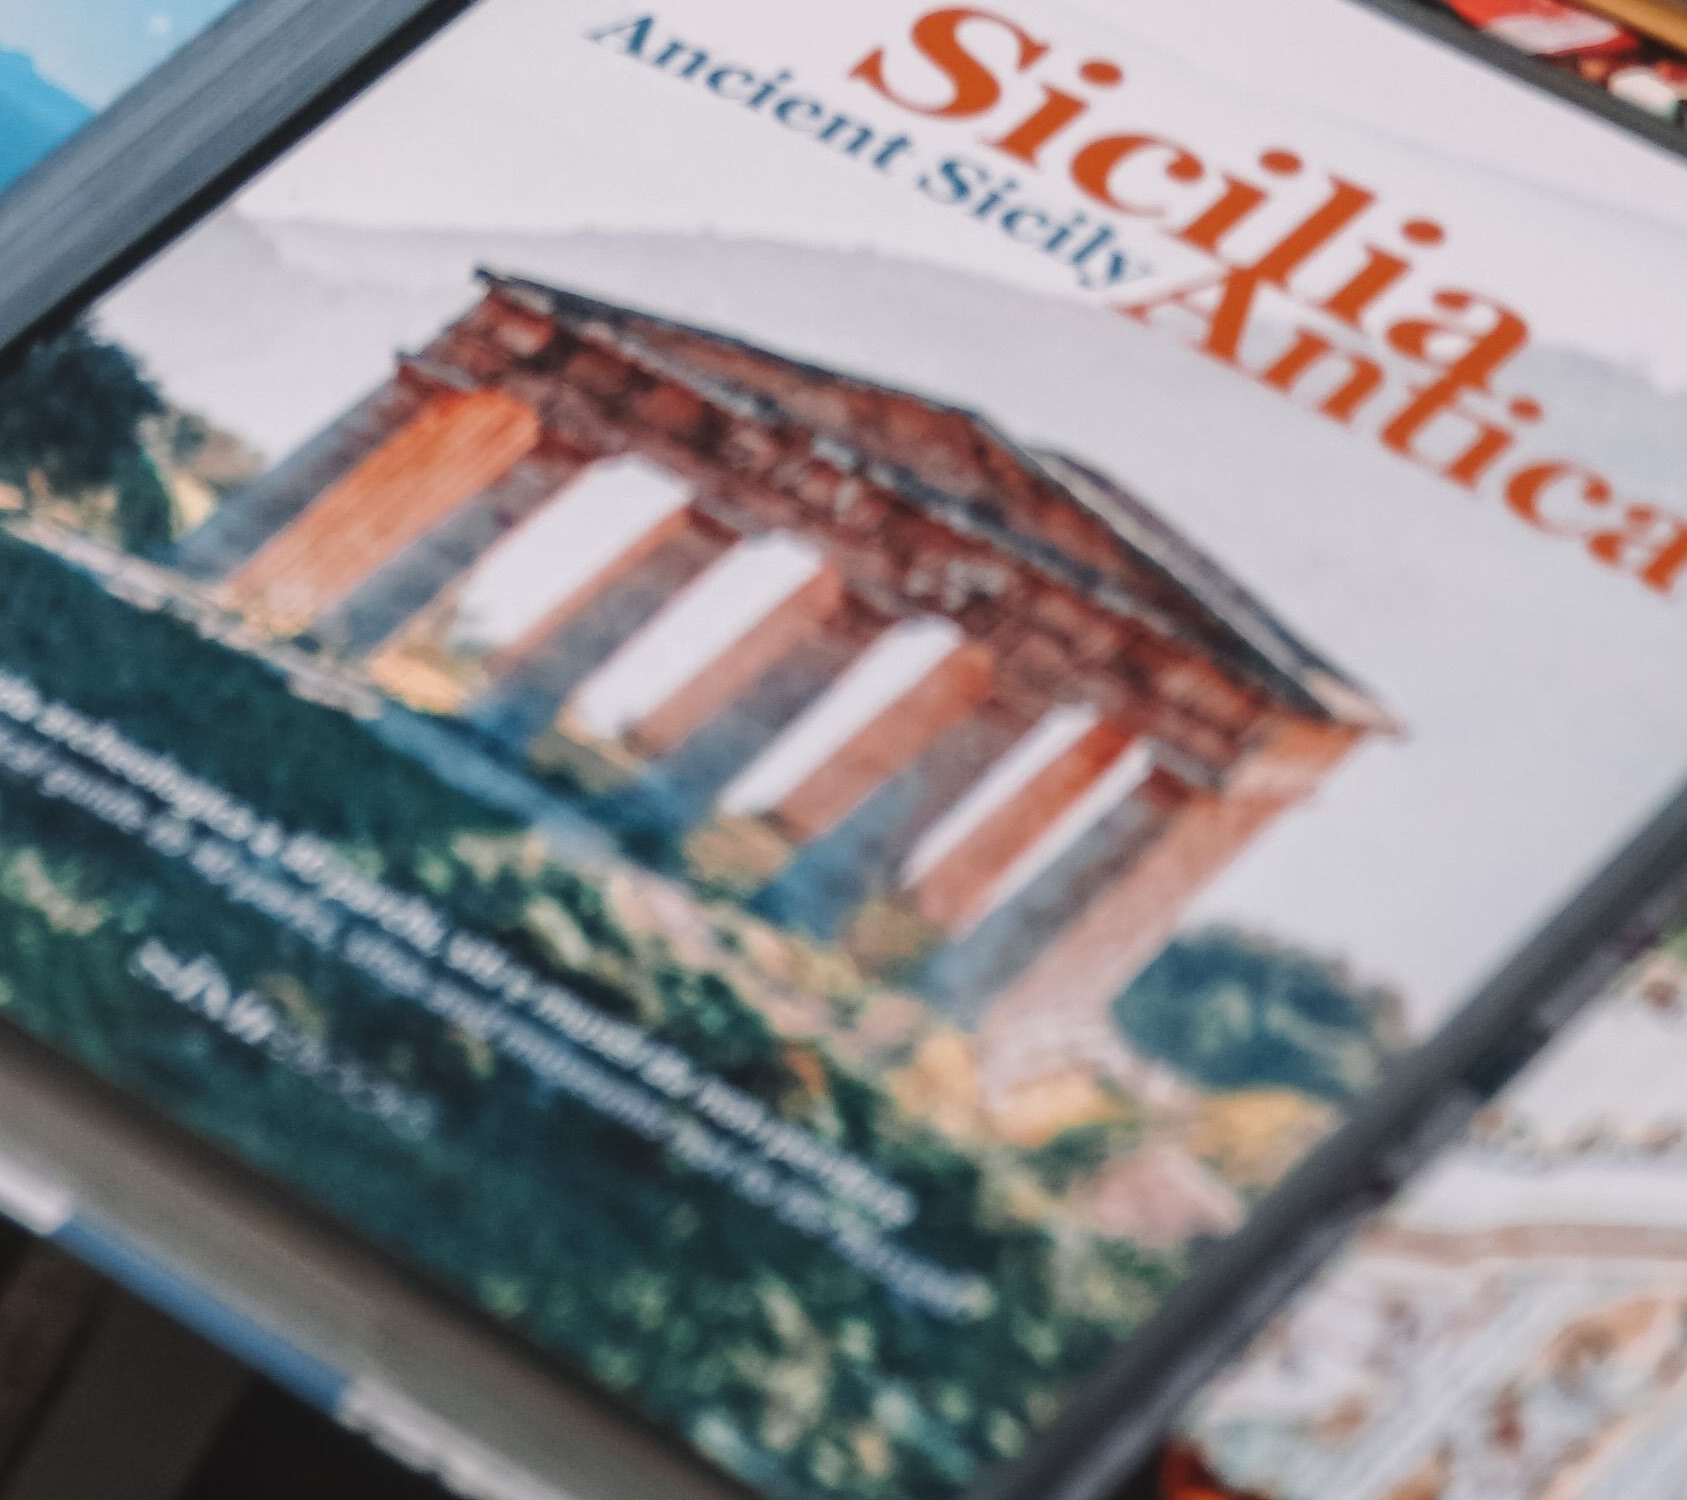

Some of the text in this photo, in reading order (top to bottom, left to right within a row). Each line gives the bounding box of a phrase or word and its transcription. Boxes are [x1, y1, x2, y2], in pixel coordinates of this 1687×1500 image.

[583, 12, 1154, 289] Ancient Sicily
[847, 2, 1531, 400] Sicilia
[1110, 260, 1687, 601] Antica
